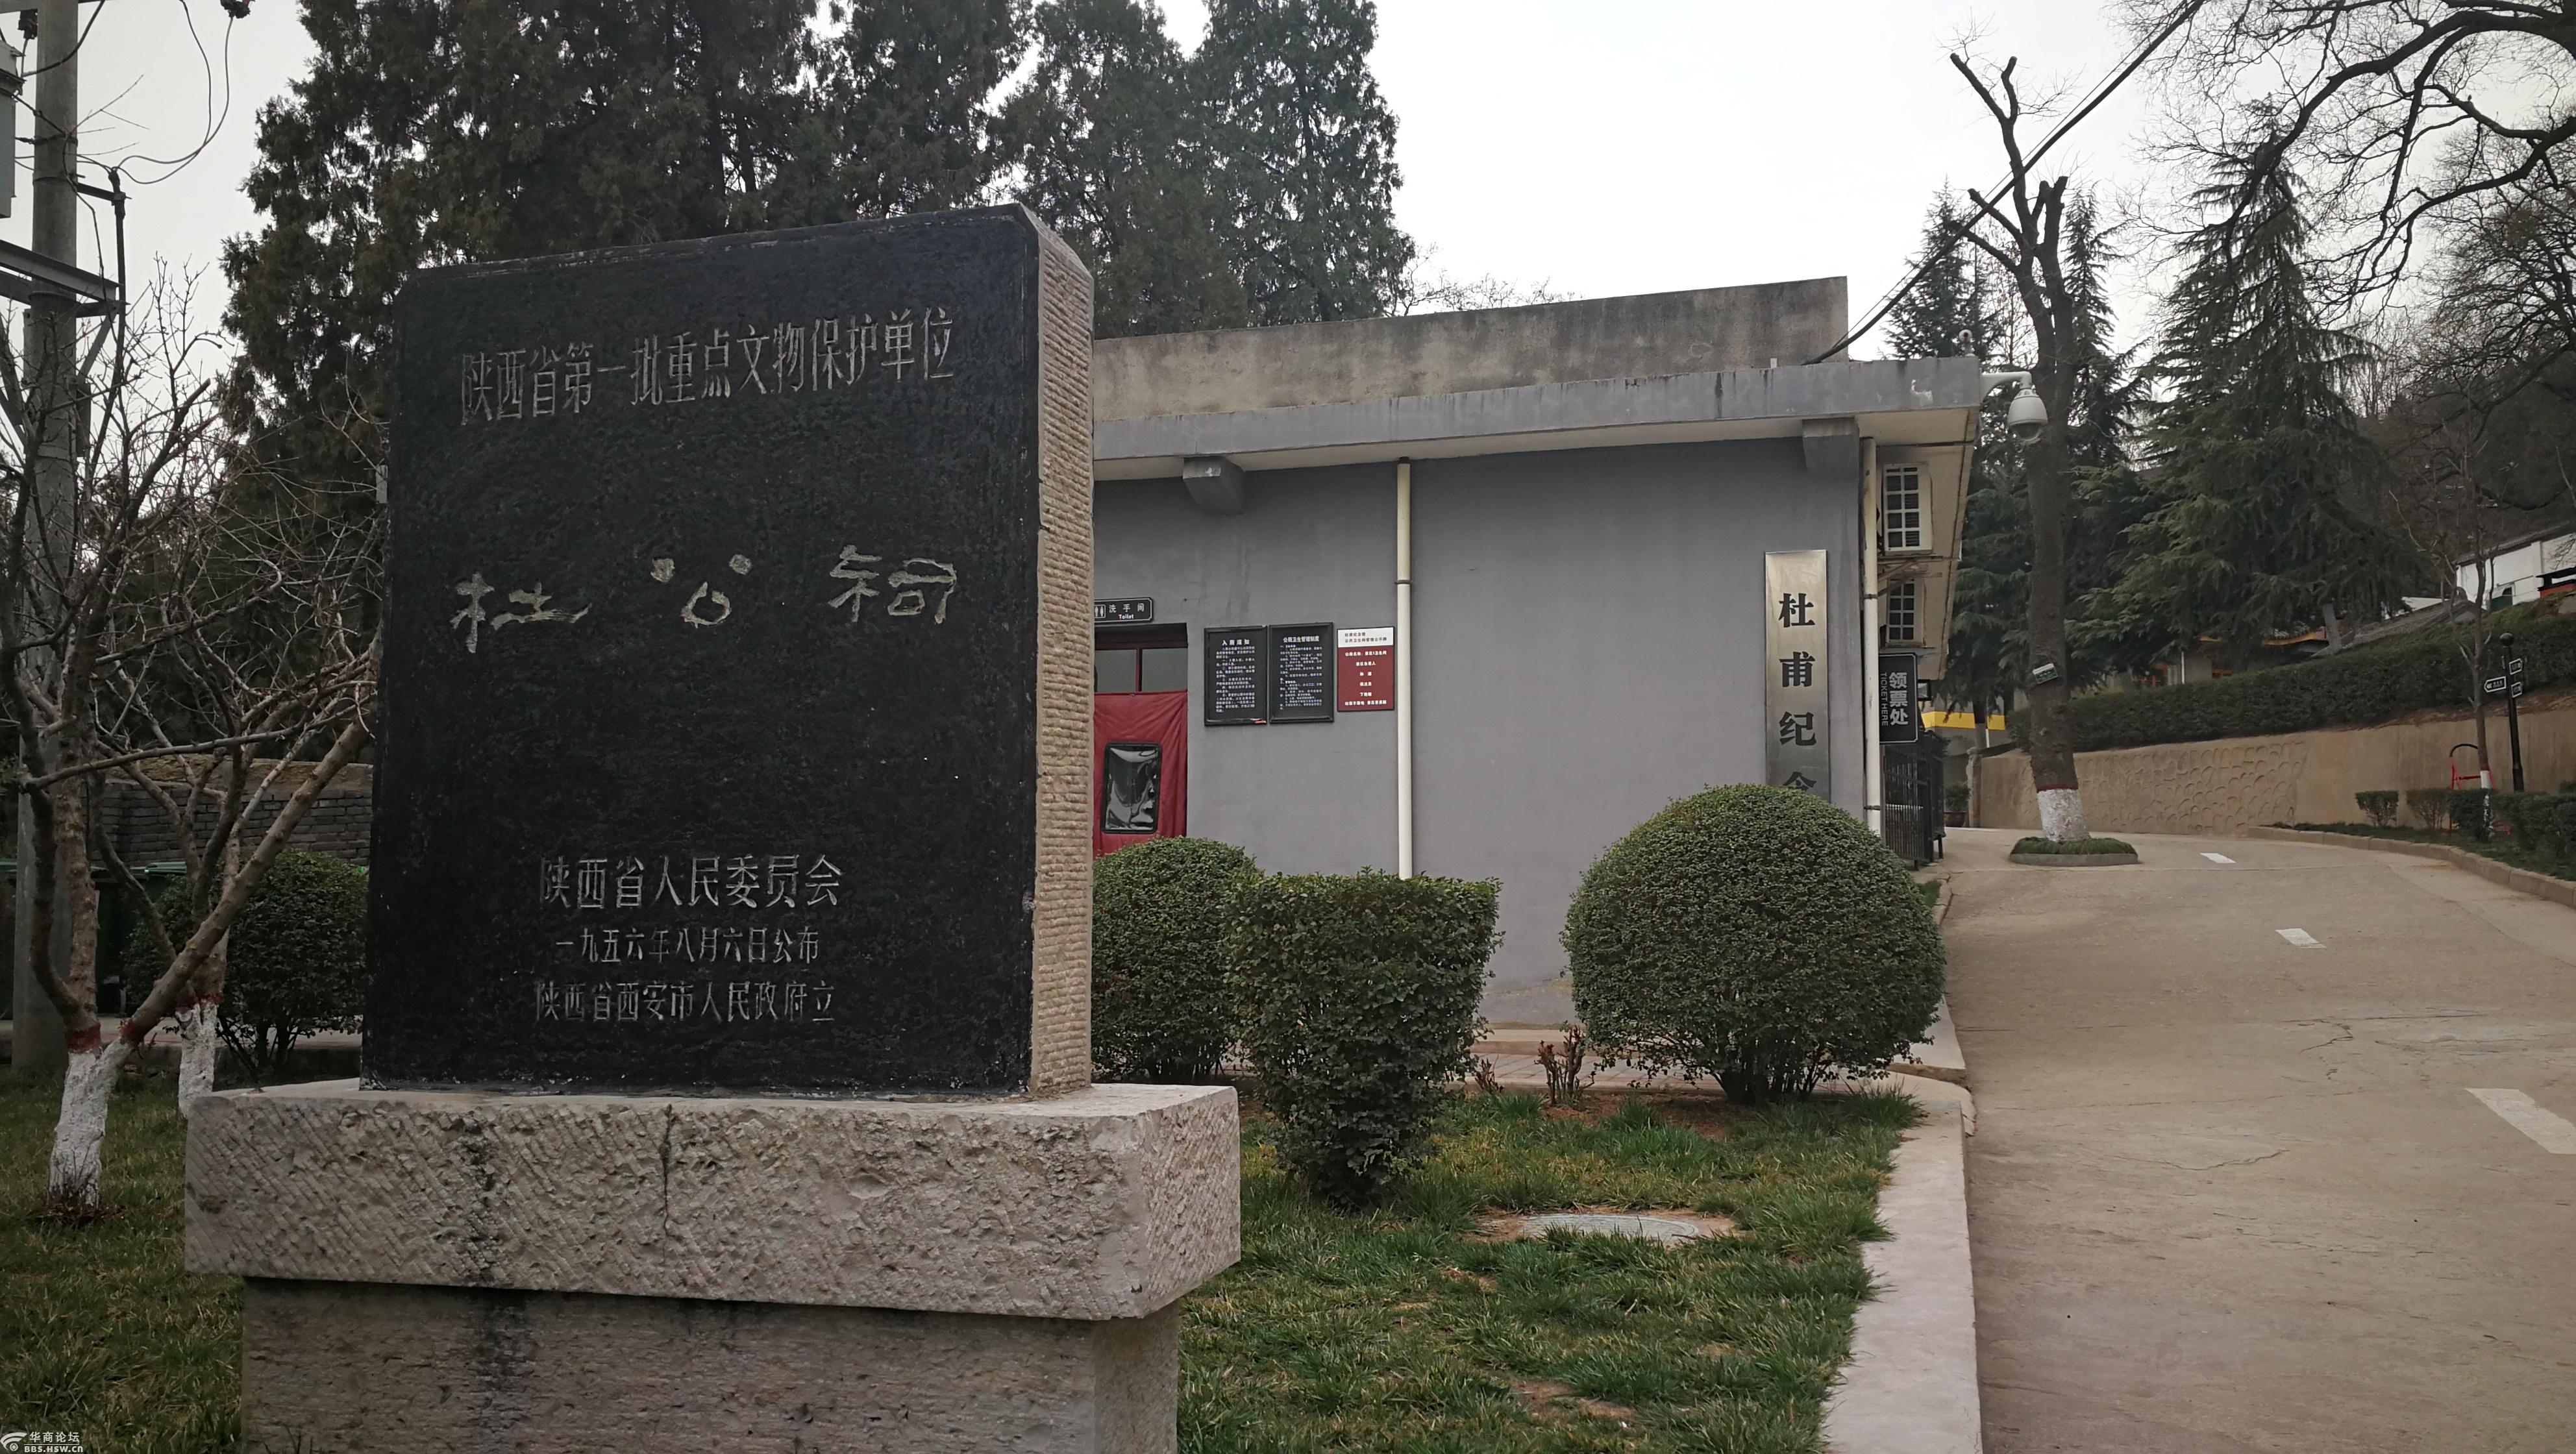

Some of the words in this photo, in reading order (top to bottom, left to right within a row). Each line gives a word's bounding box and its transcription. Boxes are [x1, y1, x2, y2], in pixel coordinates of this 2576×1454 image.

[461, 306, 953, 425] 陕西省第一批重点文物保护单位
[450, 545, 957, 654] 杜公祠
[1109, 603, 1145, 613] 洗手间
[1889, 672, 1909, 726] 领票处
[539, 854, 842, 909] 陕西省人民委员会
[555, 926, 819, 964] 一九五六年八月六日公布
[535, 980, 835, 1022] 陕西省西安市人民政府立
